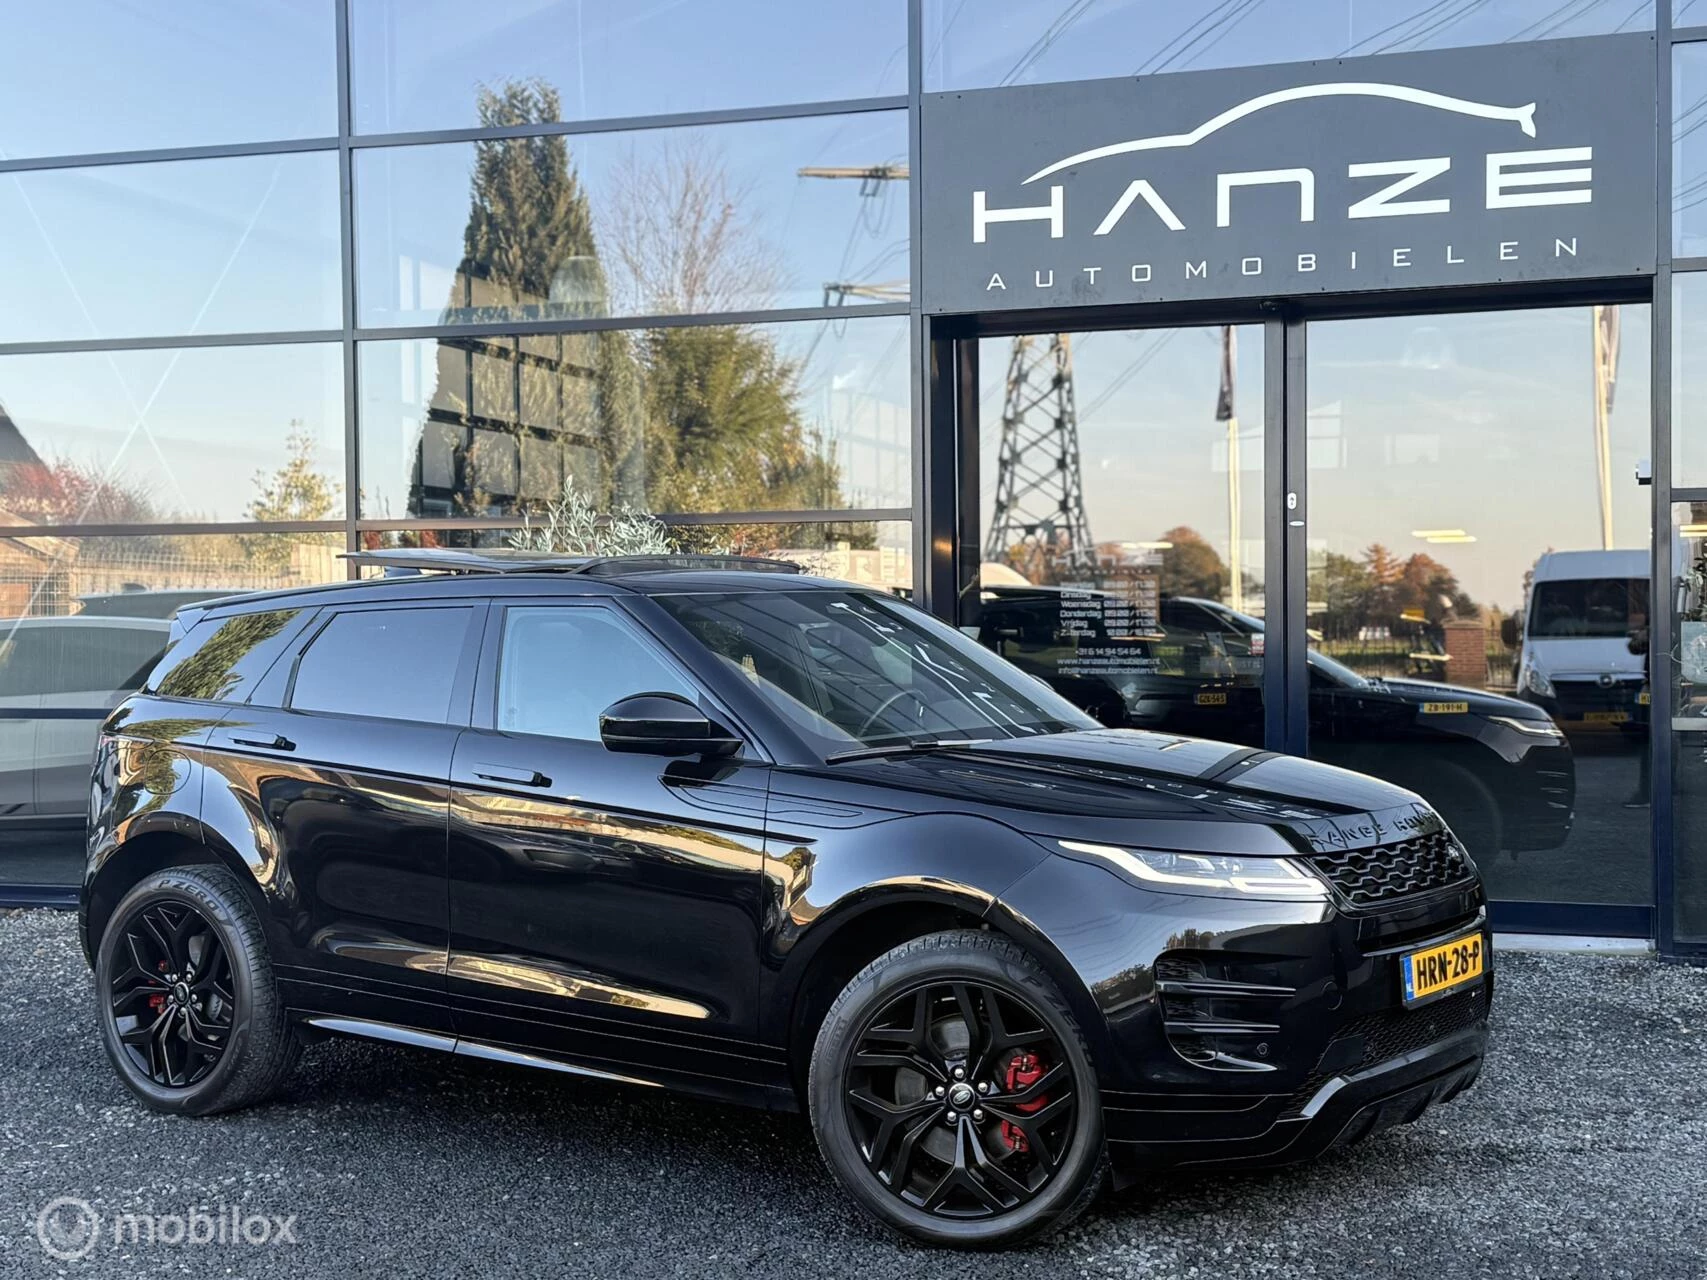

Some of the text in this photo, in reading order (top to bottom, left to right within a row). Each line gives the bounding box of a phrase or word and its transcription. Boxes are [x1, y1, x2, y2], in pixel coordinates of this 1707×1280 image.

[972, 146, 1593, 244] HANZE
[986, 236, 1578, 291] AUTOMOBIELEN
[1060, 610, 1102, 619] Donderdag
[1060, 619, 1089, 629] Vrijdag
[173, 879, 222, 912] ZERO
[1415, 940, 1480, 990] HRN-28-P
